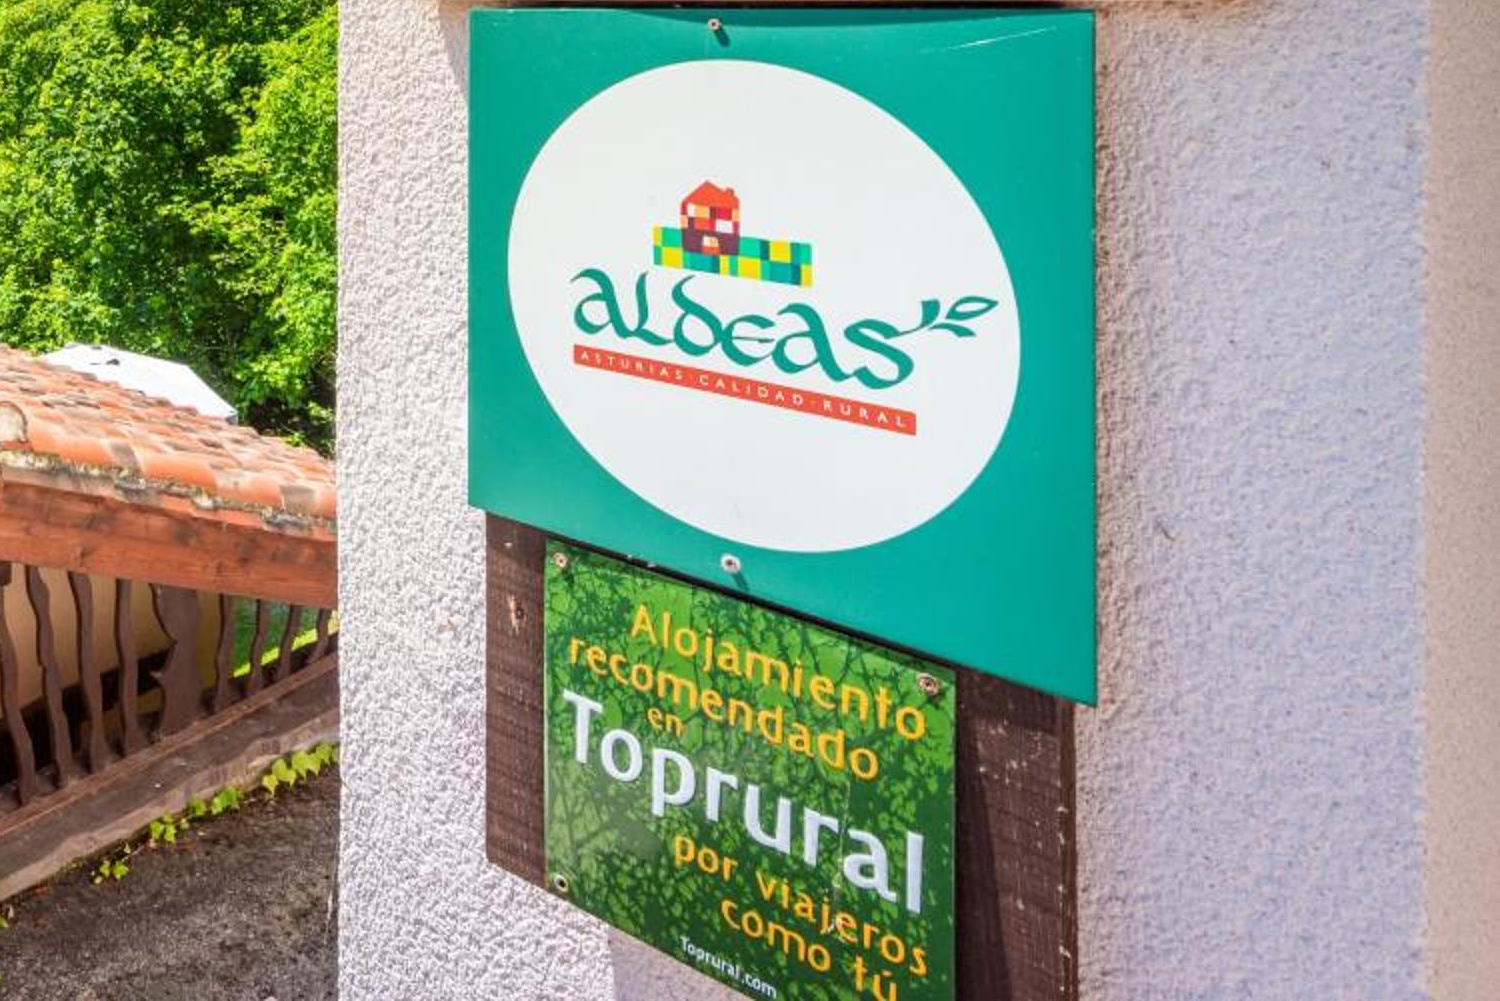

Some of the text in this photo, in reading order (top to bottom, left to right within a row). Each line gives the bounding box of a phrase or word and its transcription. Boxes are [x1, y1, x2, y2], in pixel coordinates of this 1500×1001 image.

[580, 350, 906, 428] ASTURIAS CALIDAD RURAL
[569, 636, 879, 780] recomendado
[630, 604, 927, 741] Alojamiento
[647, 707, 685, 738] en
[563, 689, 924, 915] Toprural
[674, 835, 928, 977] por viajeros
[721, 899, 897, 1001] como tú
[680, 935, 777, 1000] Toprural.com
